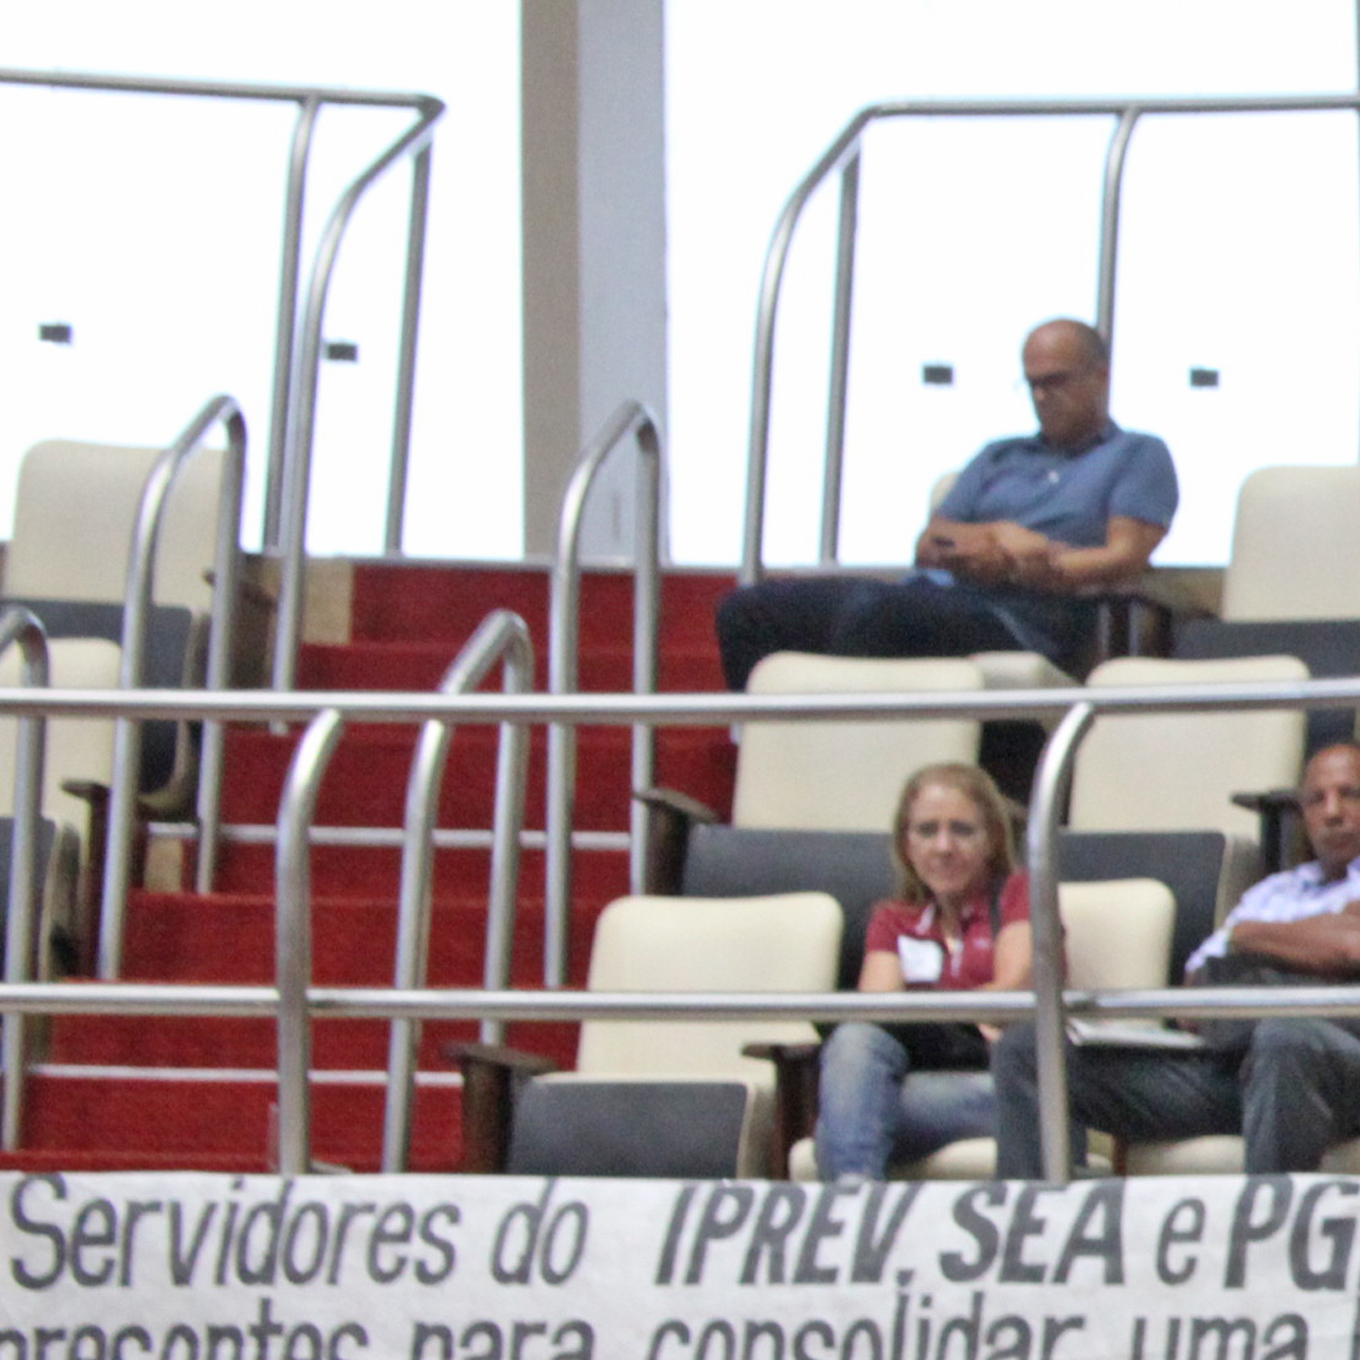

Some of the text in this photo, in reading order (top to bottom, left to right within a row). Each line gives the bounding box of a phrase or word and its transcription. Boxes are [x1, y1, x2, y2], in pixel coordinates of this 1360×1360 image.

[11, 1172, 460, 1291] Servidores
[491, 1178, 588, 1286] do
[938, 1176, 1126, 1284] SEA
[1156, 1199, 1206, 1286] e
